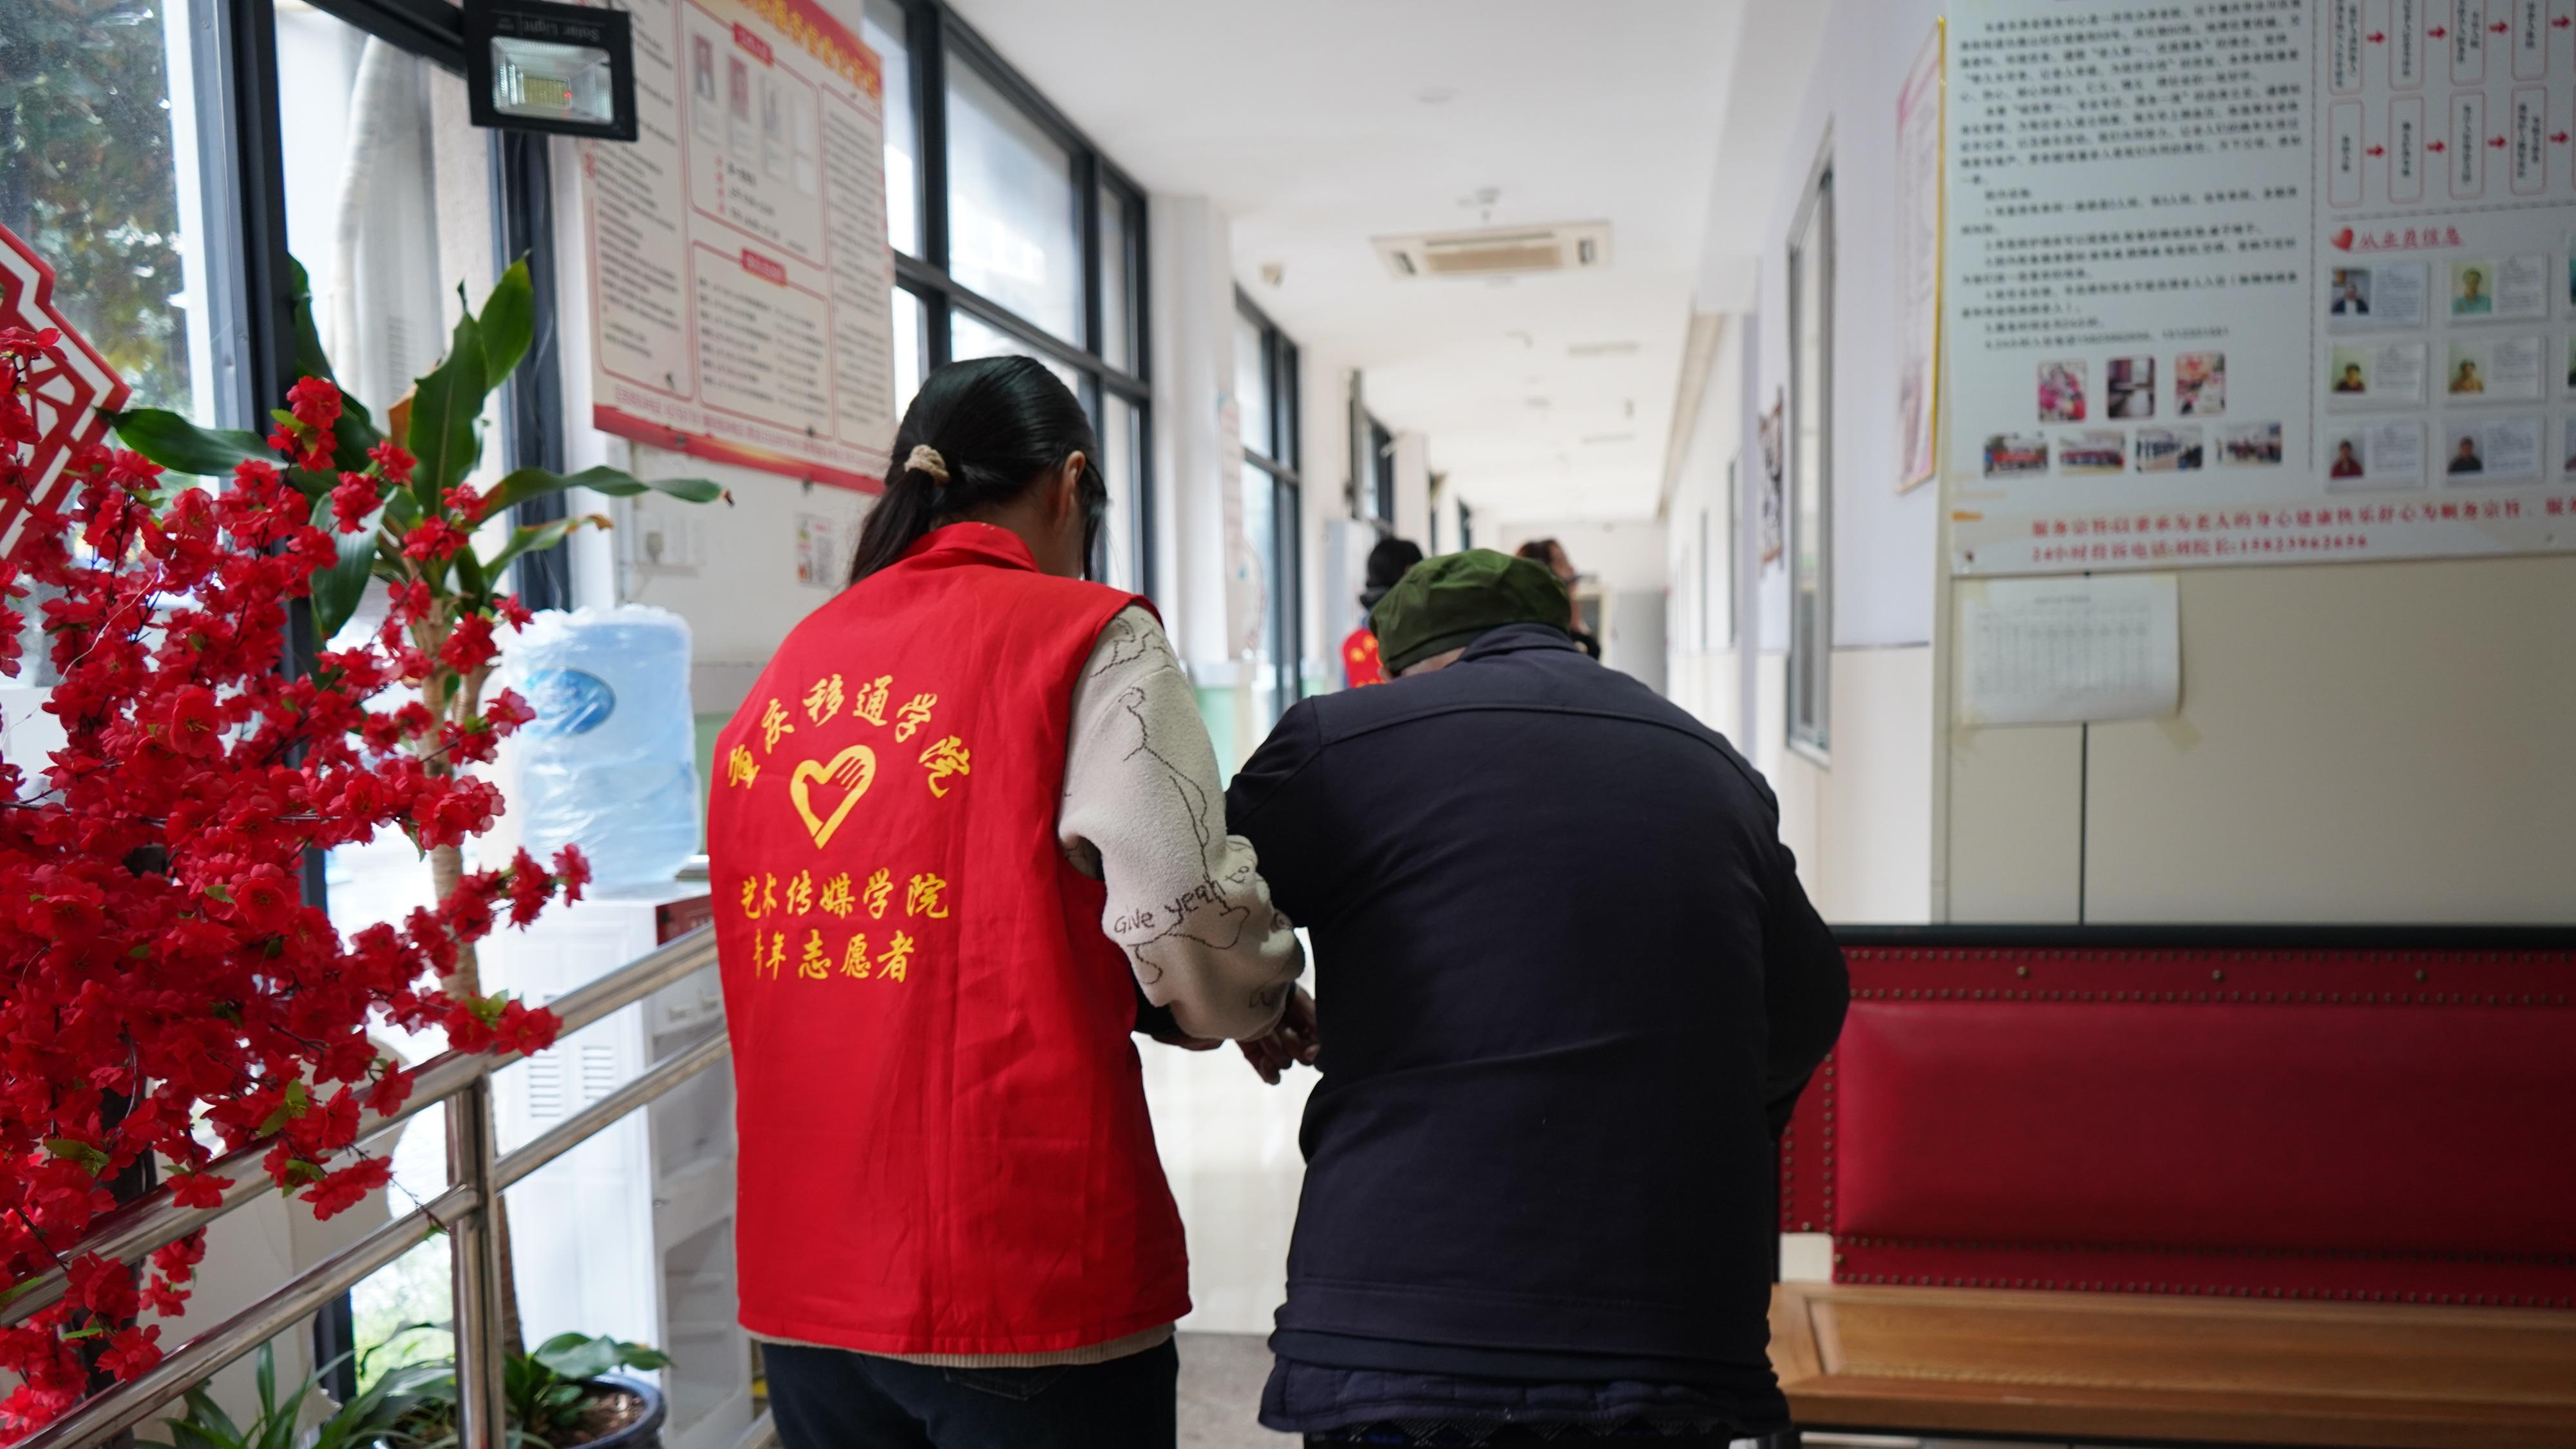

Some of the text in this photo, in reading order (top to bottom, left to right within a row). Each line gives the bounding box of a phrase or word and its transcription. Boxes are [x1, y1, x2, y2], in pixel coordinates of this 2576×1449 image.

[728, 673, 971, 799] 重庆移通学院
[741, 867, 950, 921] 艺术传媒学院
[1113, 907, 1155, 934] Give
